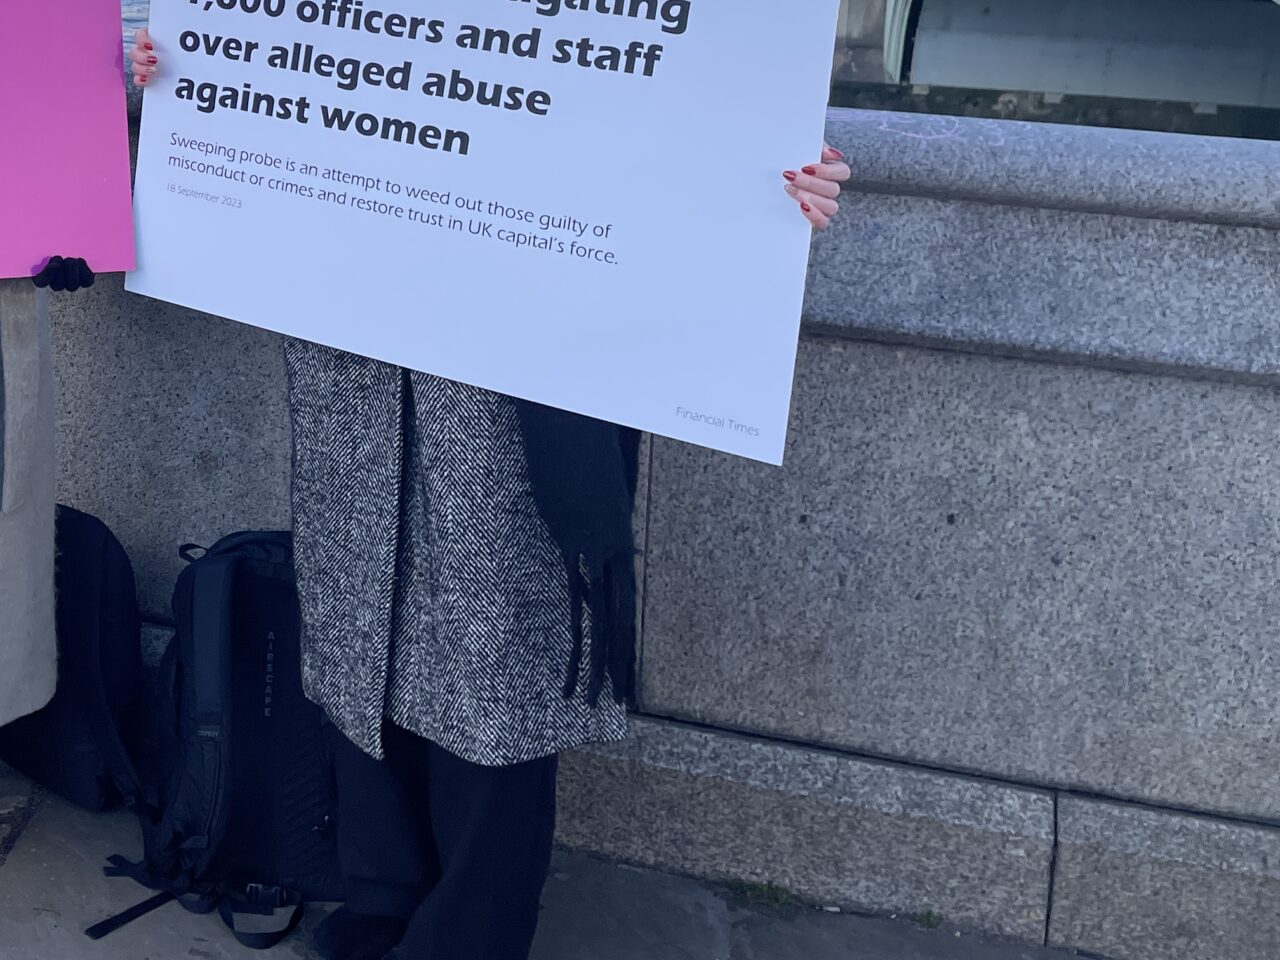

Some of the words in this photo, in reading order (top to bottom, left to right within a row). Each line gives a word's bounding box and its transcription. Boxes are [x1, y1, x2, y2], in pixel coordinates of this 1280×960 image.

[179, 30, 259, 63] over
[267, 41, 413, 91] alleged
[421, 69, 551, 116] abuse
[455, 24, 542, 59] and
[551, 37, 664, 77] staff
[174, 77, 311, 124] against
[320, 104, 470, 156] women
[166, 183, 177, 193] 18
[177, 185, 220, 203] September
[220, 195, 242, 209] 2023
[168, 155, 246, 183] misconduct
[249, 174, 265, 187] or
[267, 178, 314, 198] crimes
[317, 189, 347, 205] and
[350, 196, 404, 218] restore
[408, 207, 444, 228] trust
[448, 217, 463, 231] in
[468, 219, 493, 238] UK
[570, 241, 618, 265] force.
[169, 132, 237, 163] Sweeping
[239, 150, 282, 169] probe
[285, 157, 296, 172] is
[299, 163, 319, 177] an
[321, 168, 382, 192] attempt
[385, 179, 401, 195] to
[405, 185, 451, 205] weed
[454, 196, 483, 213] out
[487, 201, 535, 223] those
[539, 214, 589, 238] guilty
[592, 223, 613, 239] of
[675, 406, 725, 428] Financial
[727, 418, 760, 437] Times
[264, 631, 275, 717] AIRSCAPE
